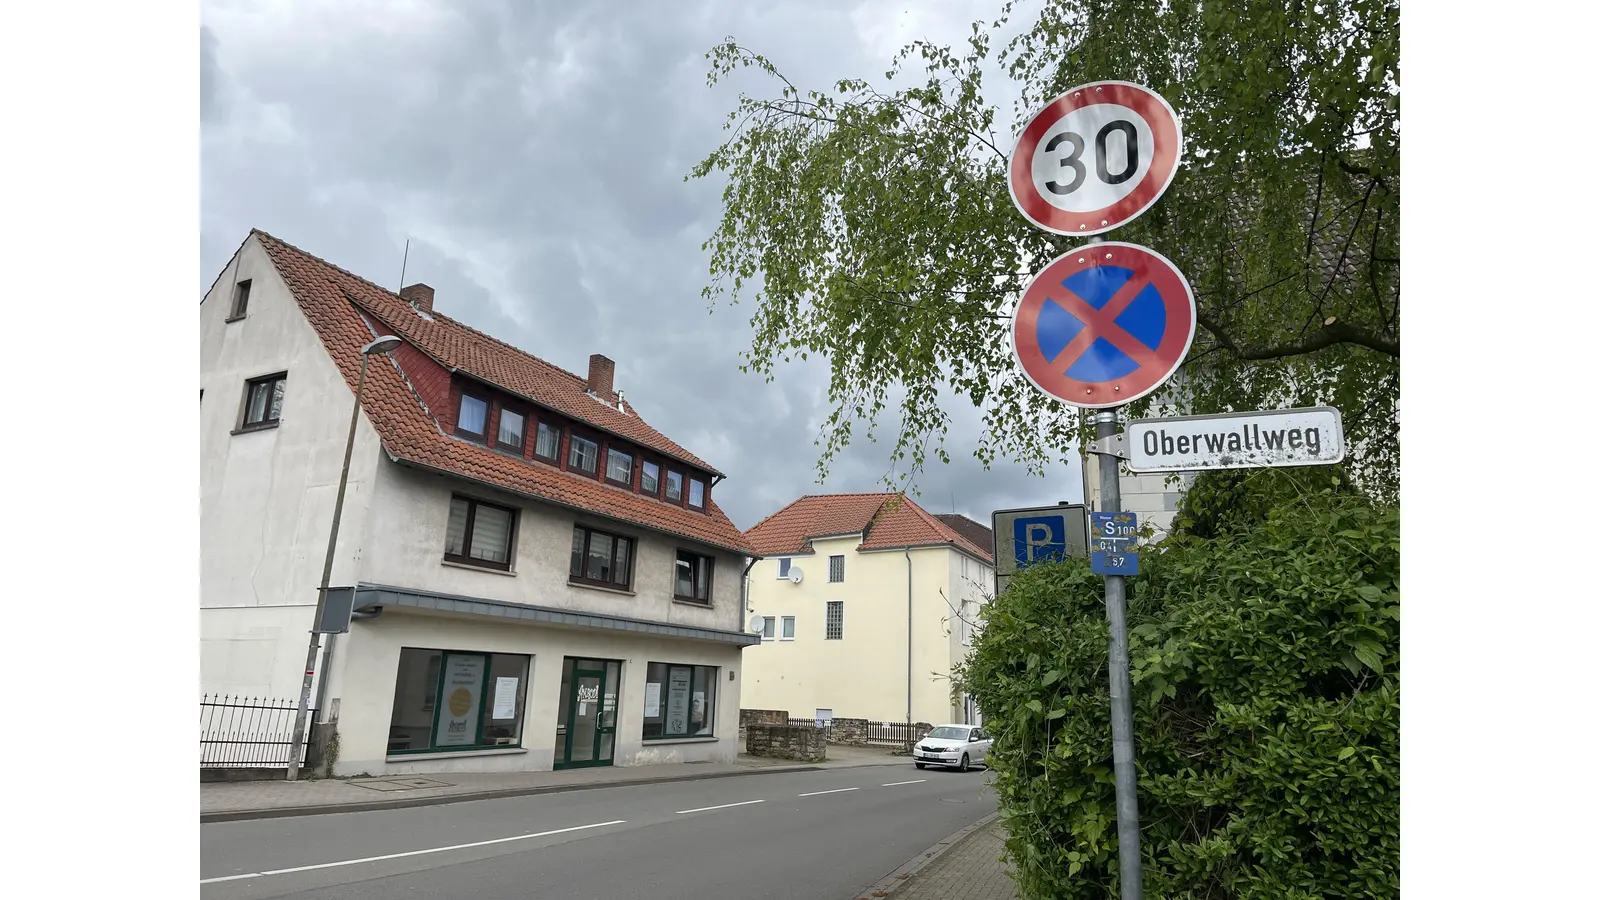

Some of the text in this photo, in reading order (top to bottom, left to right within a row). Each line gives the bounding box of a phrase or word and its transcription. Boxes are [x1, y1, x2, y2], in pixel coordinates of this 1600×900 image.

[1044, 119, 1140, 196] 30
[1143, 423, 1321, 457] Oberwallweg
[1026, 523, 1053, 562] P
[1105, 521, 1115, 535] S
